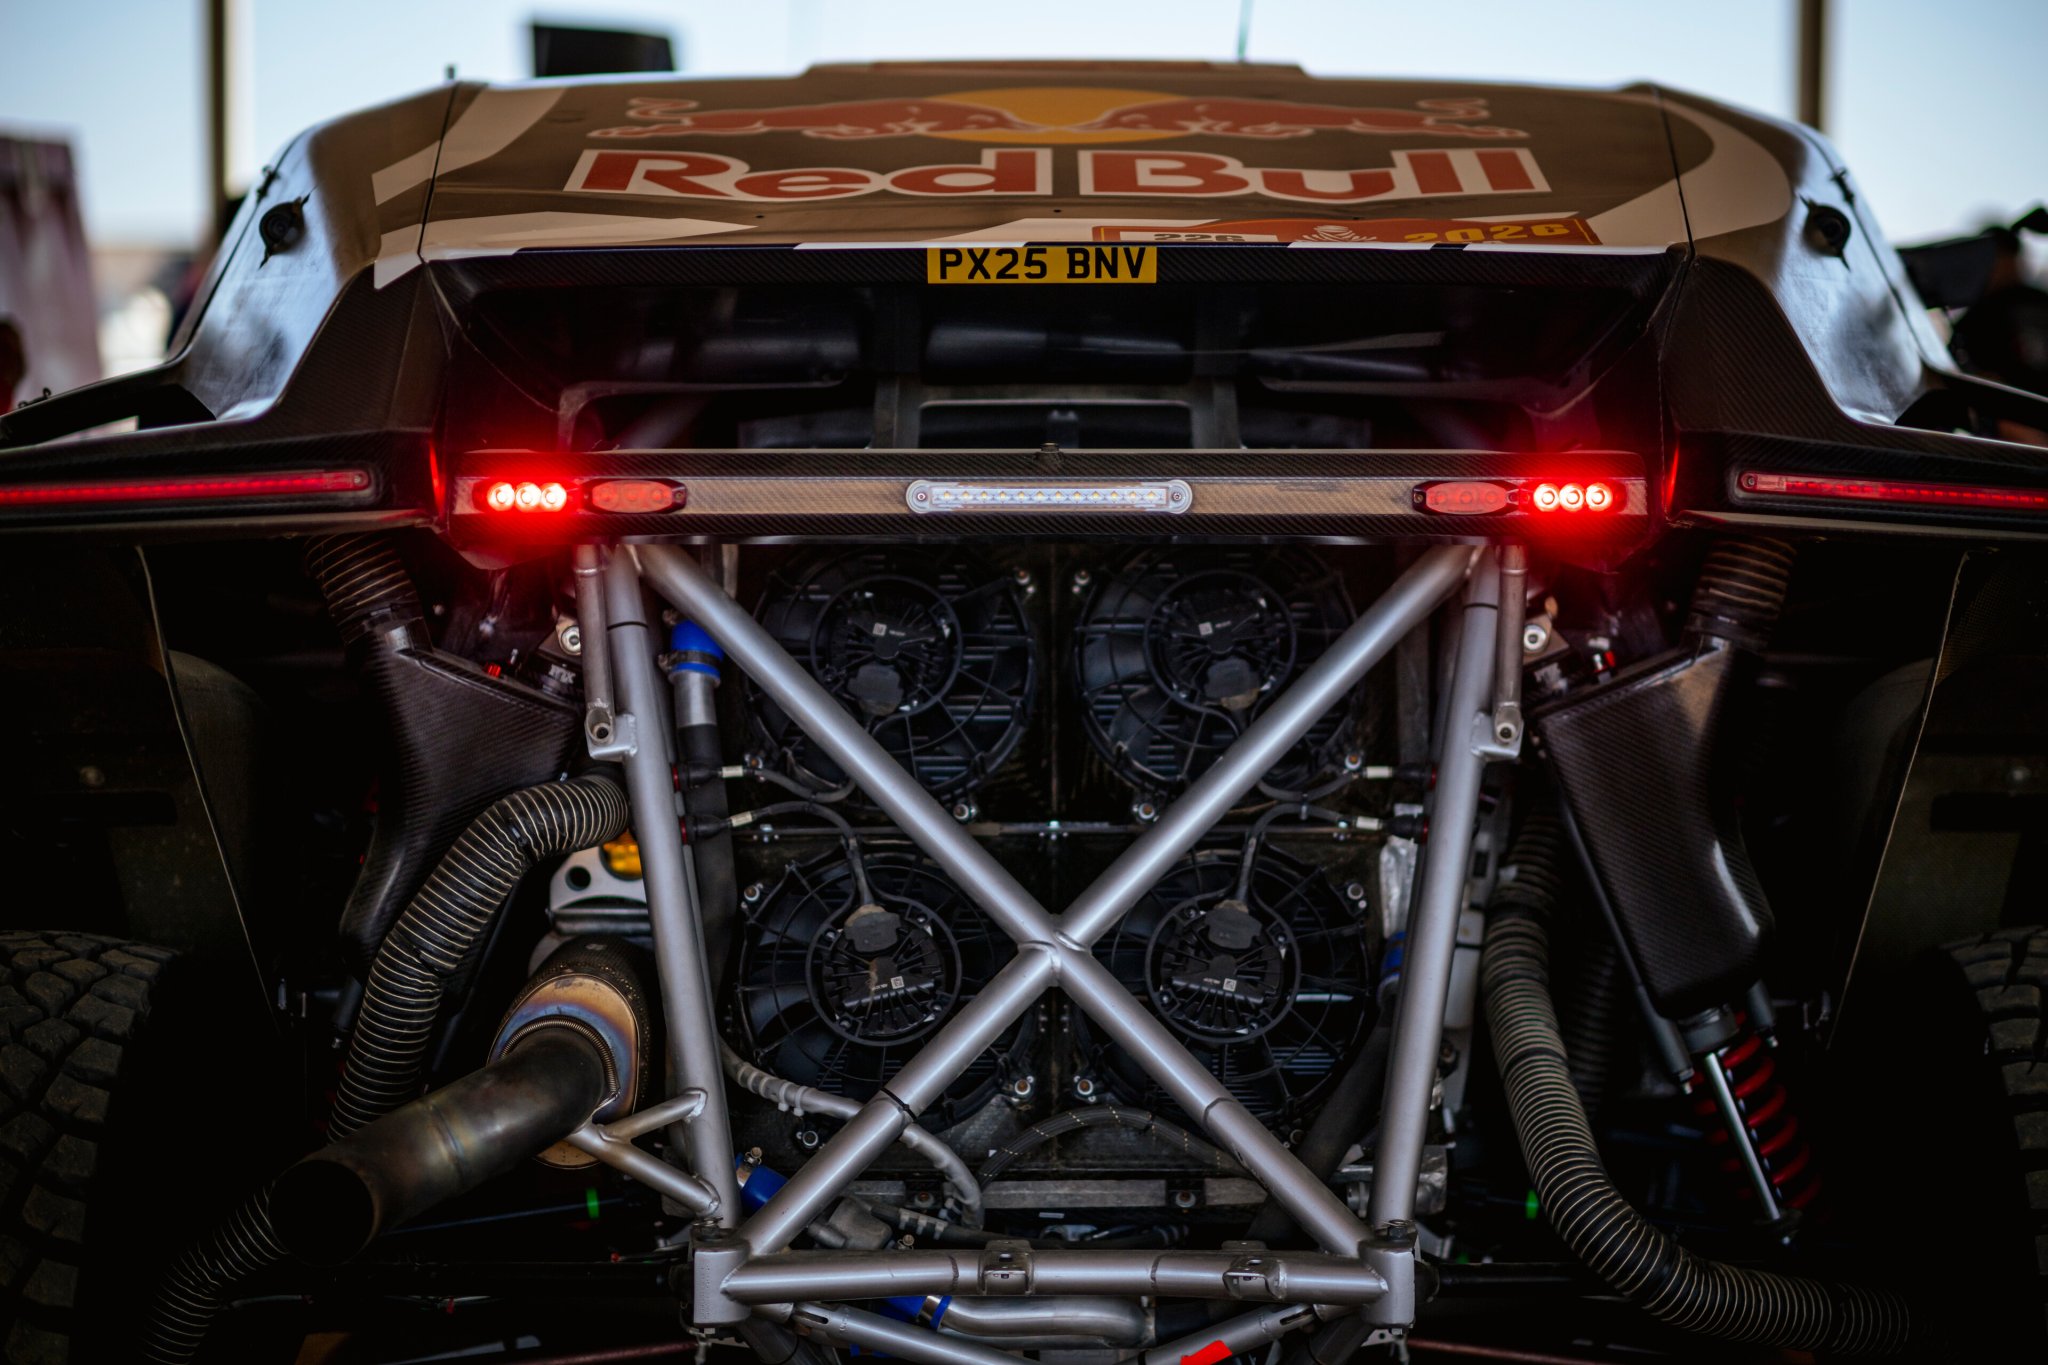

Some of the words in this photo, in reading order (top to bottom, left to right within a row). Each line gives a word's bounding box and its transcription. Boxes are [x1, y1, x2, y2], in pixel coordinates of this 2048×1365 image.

[564, 148, 1052, 201] Red
[1078, 148, 1551, 203] Bull
[1404, 224, 1570, 242] 2026
[940, 247, 1048, 279] PX25
[1066, 247, 1147, 279] BNV
